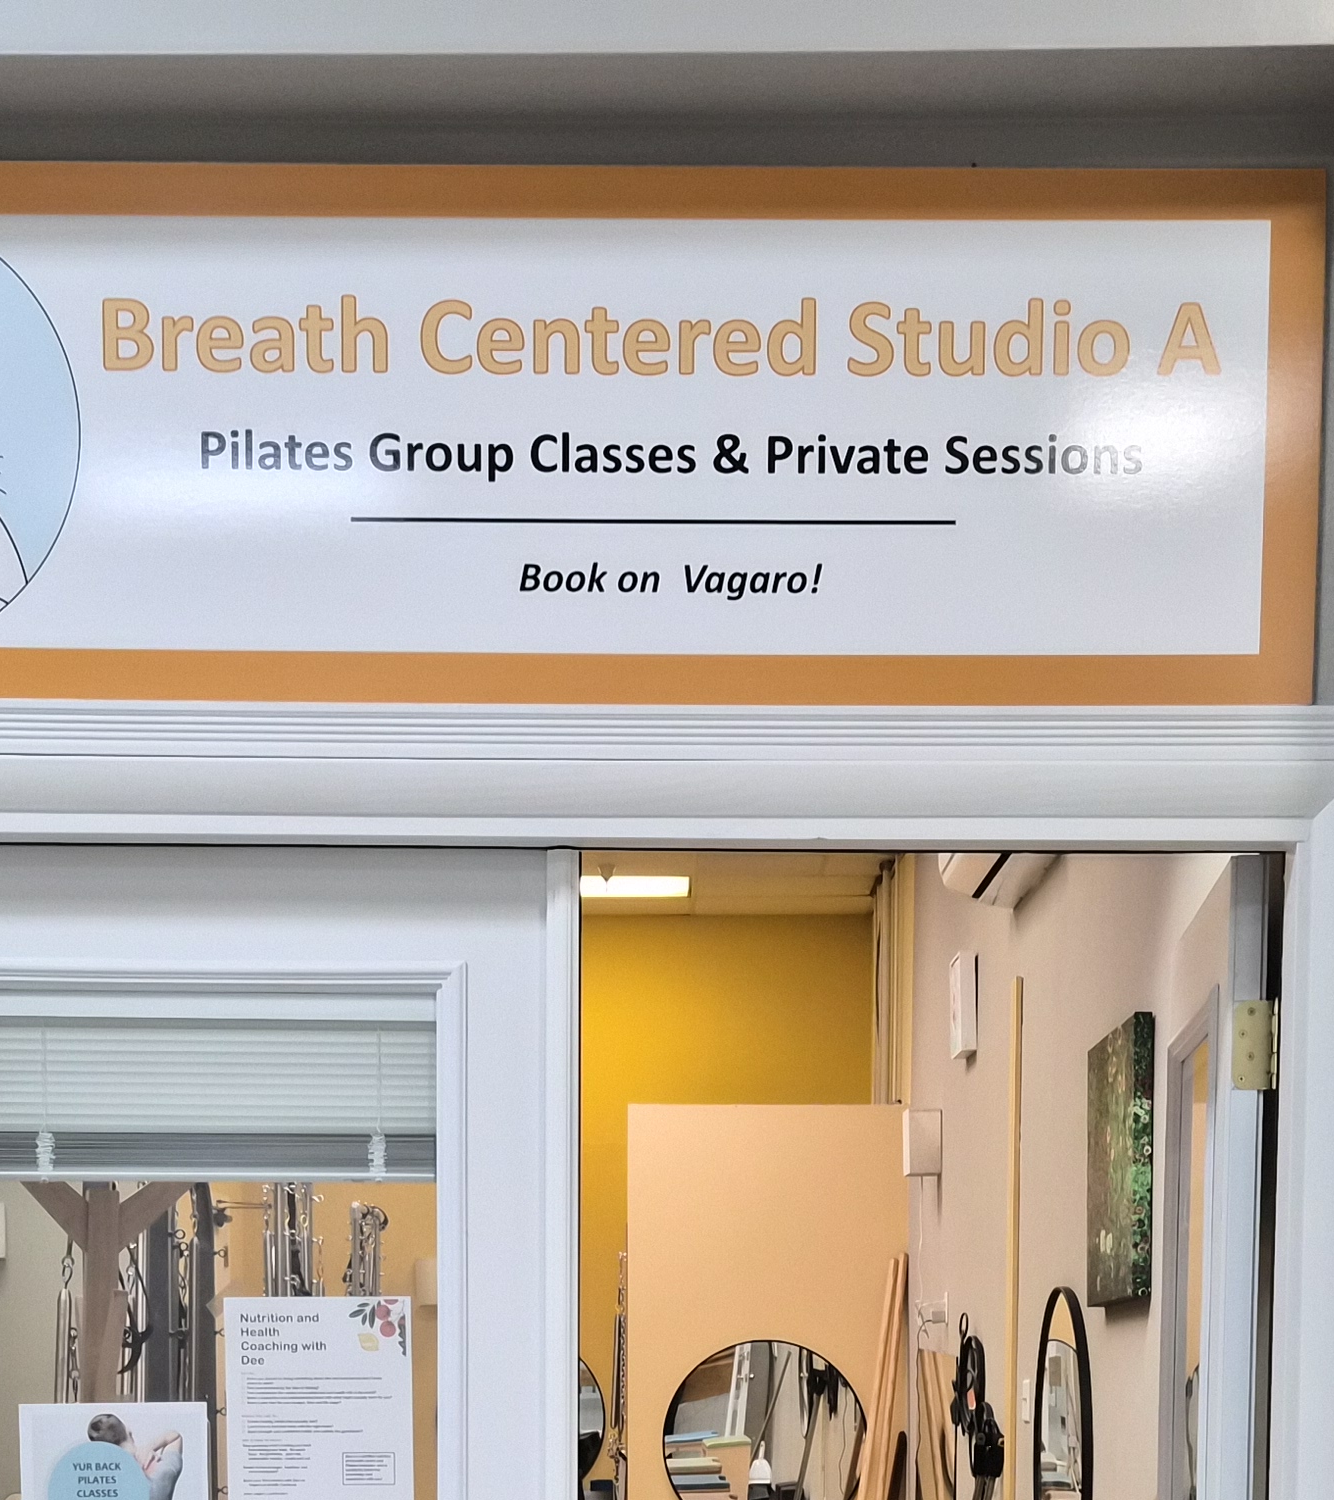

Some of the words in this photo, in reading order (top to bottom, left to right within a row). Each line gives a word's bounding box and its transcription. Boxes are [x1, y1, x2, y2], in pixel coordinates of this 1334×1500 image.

[101, 294, 390, 374] Breath
[419, 297, 818, 376] Centered
[846, 297, 1132, 378] Studio
[1156, 301, 1223, 376] A
[200, 429, 354, 472] Pilates
[368, 432, 515, 482] Group
[529, 432, 697, 474] Classes
[712, 433, 750, 475] &
[767, 434, 930, 475] Private
[944, 435, 1144, 476] Sessions
[519, 562, 608, 593] Book
[617, 569, 661, 593] on
[683, 563, 824, 601] Vagaro!
[239, 1313, 293, 1323] Nutrition
[296, 1313, 320, 1323] and
[240, 1327, 280, 1337] Health
[241, 1341, 298, 1353] Coaching
[301, 1341, 327, 1351] with
[241, 1355, 265, 1365] Dee
[72, 1463, 93, 1471] YUR
[95, 1463, 121, 1471] BACK
[77, 1475, 117, 1484] PILATES
[76, 1489, 119, 1498] CLASSES
